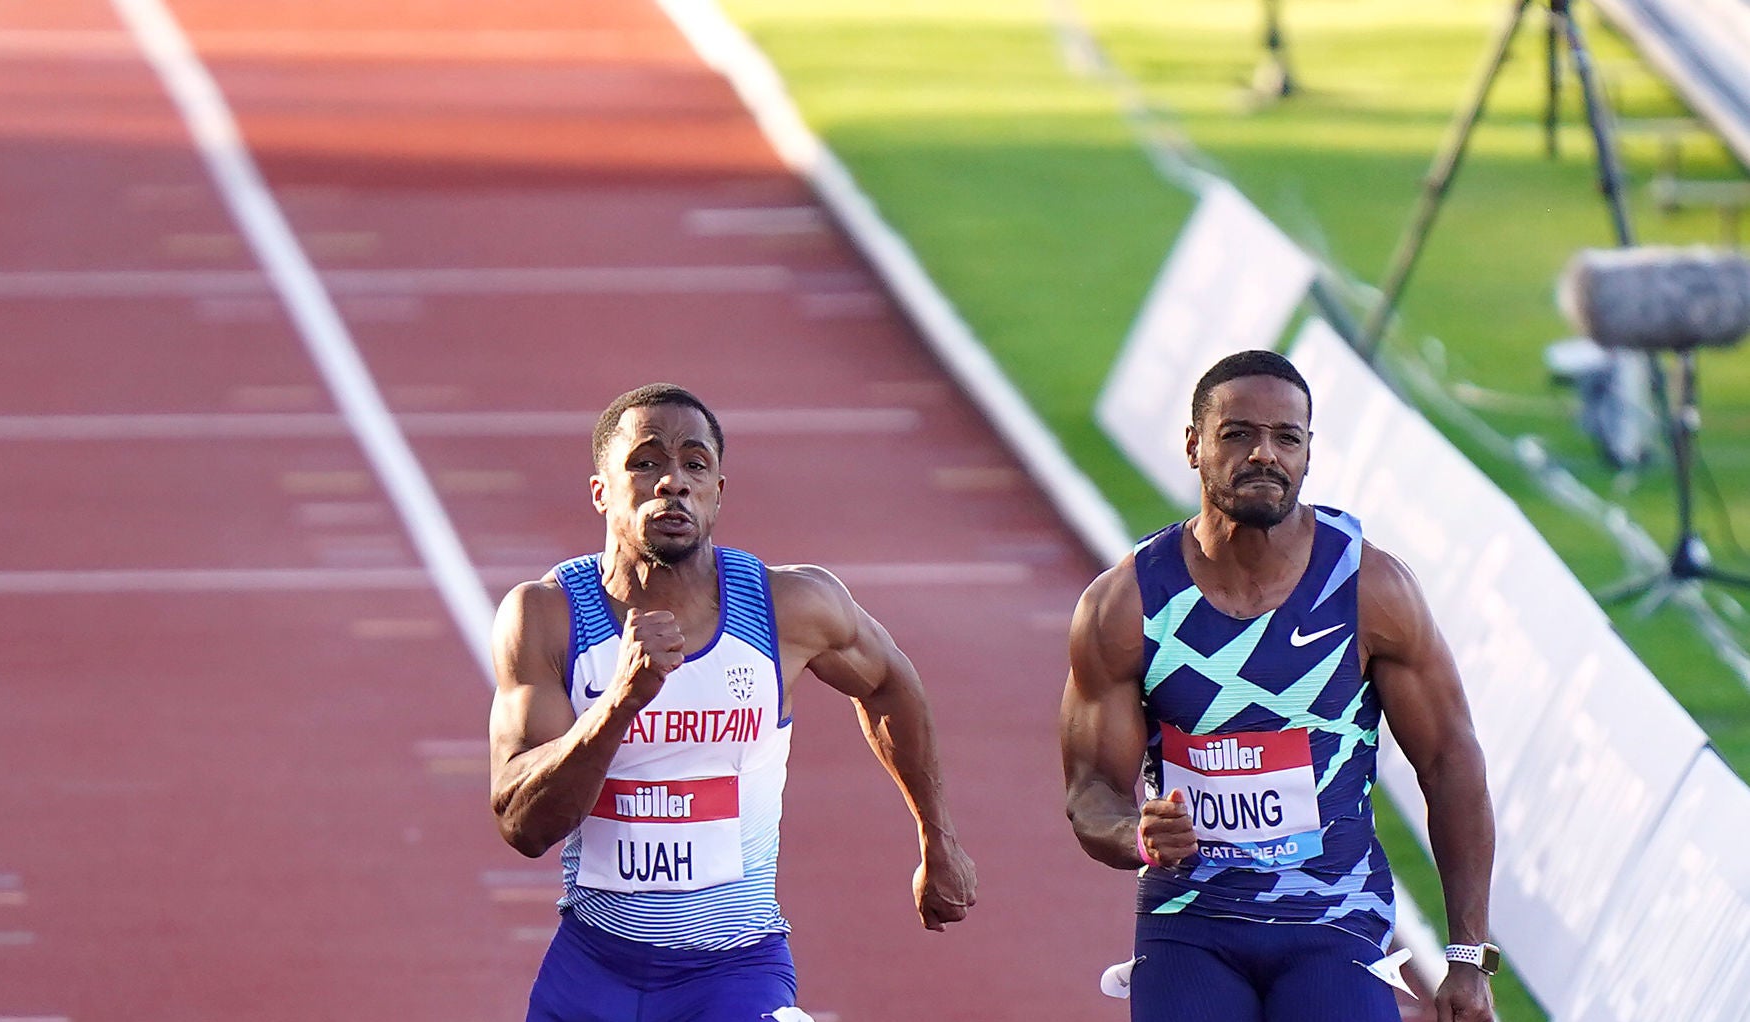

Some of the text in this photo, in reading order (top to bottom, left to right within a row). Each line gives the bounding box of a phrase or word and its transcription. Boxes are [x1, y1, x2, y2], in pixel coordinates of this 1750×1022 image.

[665, 707, 763, 744] BRITAIN
[1188, 738, 1265, 771] müller
[615, 785, 695, 818] müller
[1187, 786, 1282, 829] YOUNG
[617, 839, 693, 882] UJAH
